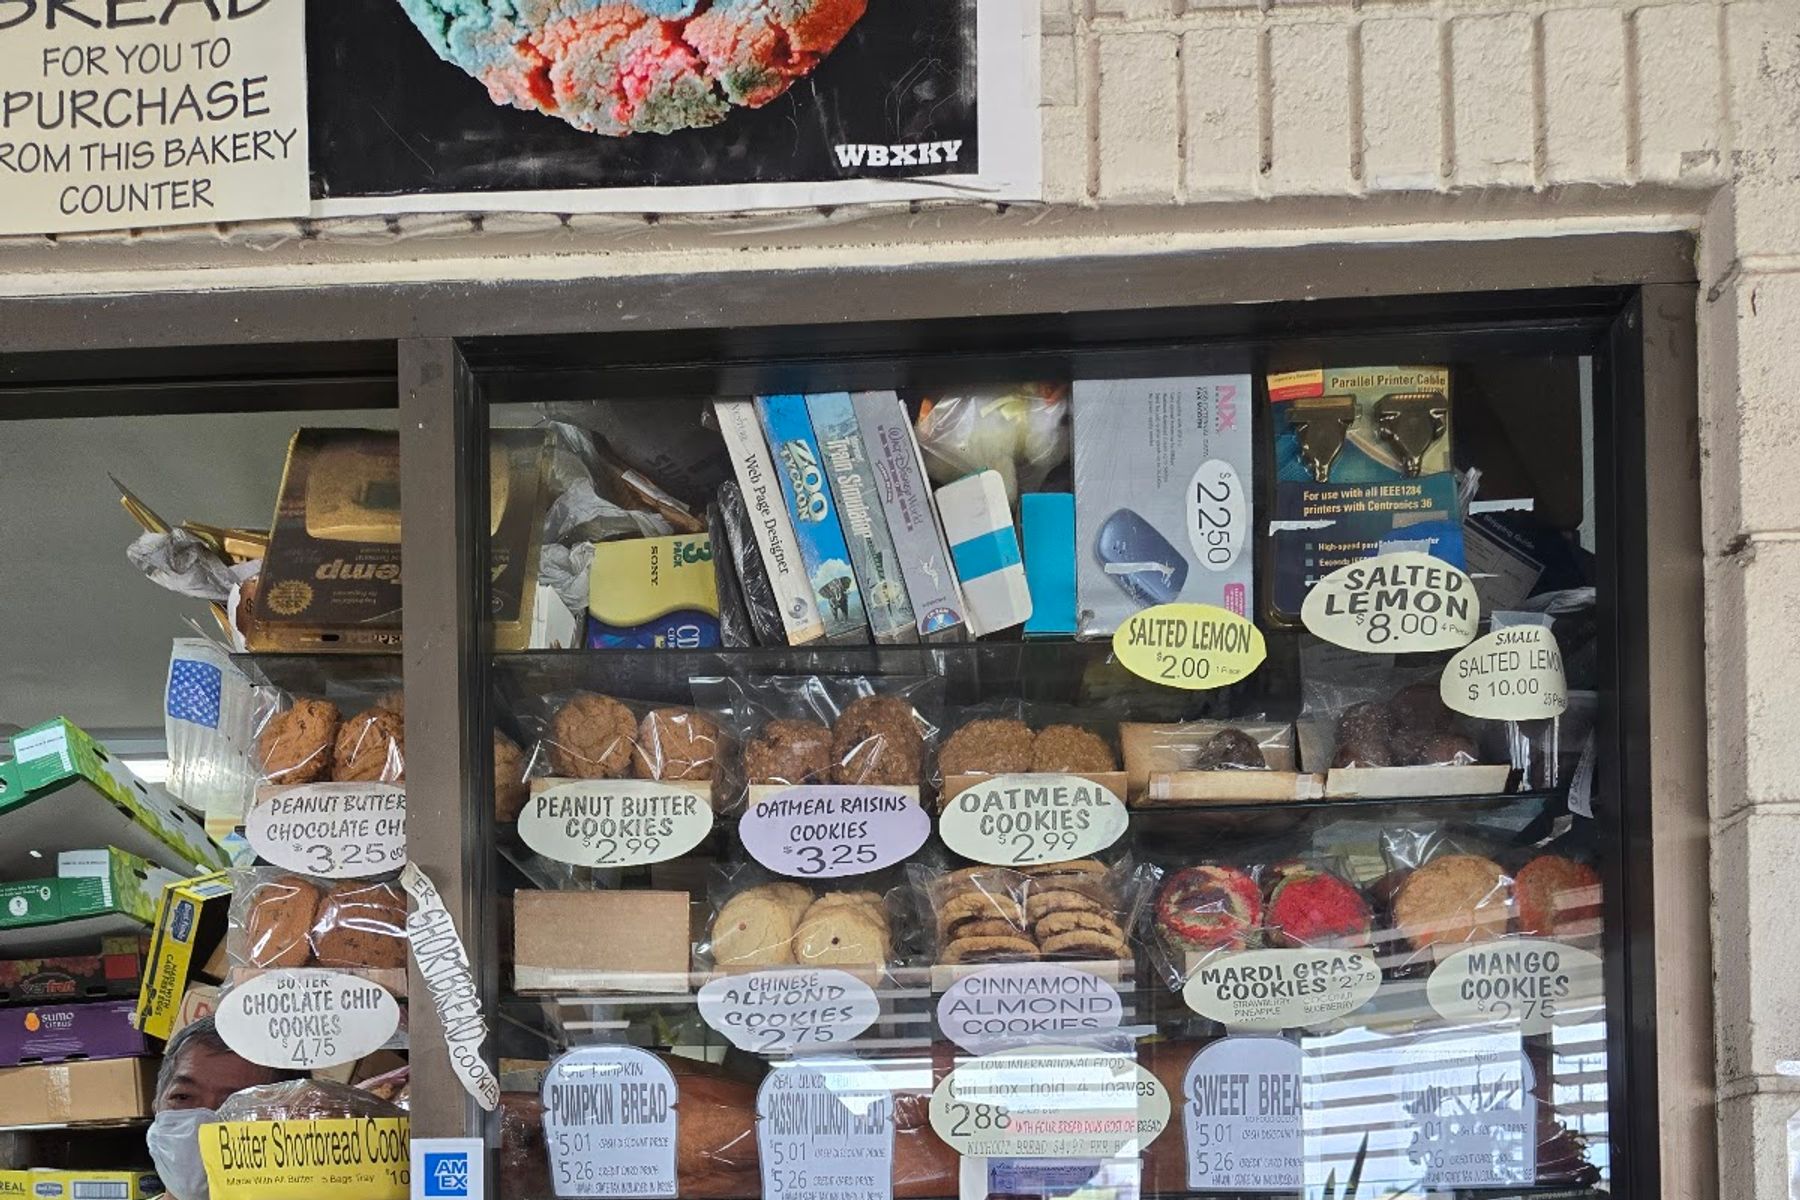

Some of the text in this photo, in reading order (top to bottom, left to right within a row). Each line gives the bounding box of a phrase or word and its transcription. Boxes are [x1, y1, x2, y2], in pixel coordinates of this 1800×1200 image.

[43, 37, 232, 77] FOR YOU TO
[3, 75, 271, 130] PURCHASE
[0, 128, 297, 173] ROM THIS BAKERY
[834, 139, 962, 168] WBXKY
[59, 178, 215, 215] COUNTER
[1331, 377, 1374, 389] Parallel
[1377, 375, 1414, 386] Printer
[1417, 374, 1446, 385] Cable
[785, 439, 828, 521] ZOO
[827, 438, 873, 538] Train Simulator
[1303, 491, 1319, 501] For
[1321, 491, 1338, 500] use
[1341, 488, 1364, 499] with
[1365, 486, 1378, 498] all
[743, 453, 789, 575] Web Page Designer
[1196, 471, 1232, 565] $22.50
[1303, 504, 1341, 517] printers
[1344, 502, 1365, 512] with
[650, 546, 658, 586] SONY
[673, 541, 683, 568] PACK
[682, 541, 713, 564] 3
[1344, 565, 1463, 593] SALTED
[1325, 588, 1469, 620] LEMON
[1128, 618, 1251, 653] SALTED LEMON
[1356, 612, 1437, 643] $8.00
[1496, 631, 1540, 646] SMALL
[1156, 651, 1209, 680] $2.00
[1459, 651, 1520, 679] SALTED
[271, 793, 406, 816] PEANUT BUTTER
[537, 795, 697, 818] PEANUT BUTTER
[756, 795, 907, 819] OATMEAL RAISINS
[960, 786, 1112, 813] OATMEAL
[266, 820, 369, 842] CHOCOLATE
[565, 818, 673, 838] COOKIES
[790, 820, 867, 842] COOKIES
[979, 809, 1090, 834] COOKIES
[293, 843, 385, 874] $3.25
[582, 835, 660, 864] $2.99
[783, 843, 878, 875] $3.25
[998, 831, 1078, 863] $2.99
[1201, 954, 1363, 984] MARDI GRAS
[1468, 951, 1560, 975] MANGO
[748, 972, 819, 992] CHINESE
[964, 975, 1098, 995] CINNAMON
[1217, 971, 1376, 1001] COOKIES $2.75
[1461, 975, 1569, 1000] COOKIES
[243, 988, 382, 1016] CHOCLATE CHIP
[722, 986, 845, 1006] ALMOND
[948, 997, 1114, 1015] ALMOND
[268, 1015, 341, 1040] COOKIES
[725, 1005, 854, 1028] COOKIES
[282, 1037, 336, 1066] $4.75
[550, 1083, 667, 1126] PUMPKIN BREAD
[1193, 1074, 1303, 1117] SWEET BREA
[945, 1102, 1012, 1137] $2.88
[219, 1121, 361, 1170] Butter Shortbread
[555, 1132, 592, 1156] $5.01
[1195, 1121, 1233, 1146] $5.01
[769, 1140, 806, 1165] $5.01
[1196, 1149, 1234, 1175] $5.26
[436, 1160, 467, 1174] AM
[558, 1160, 594, 1184] $5.26
